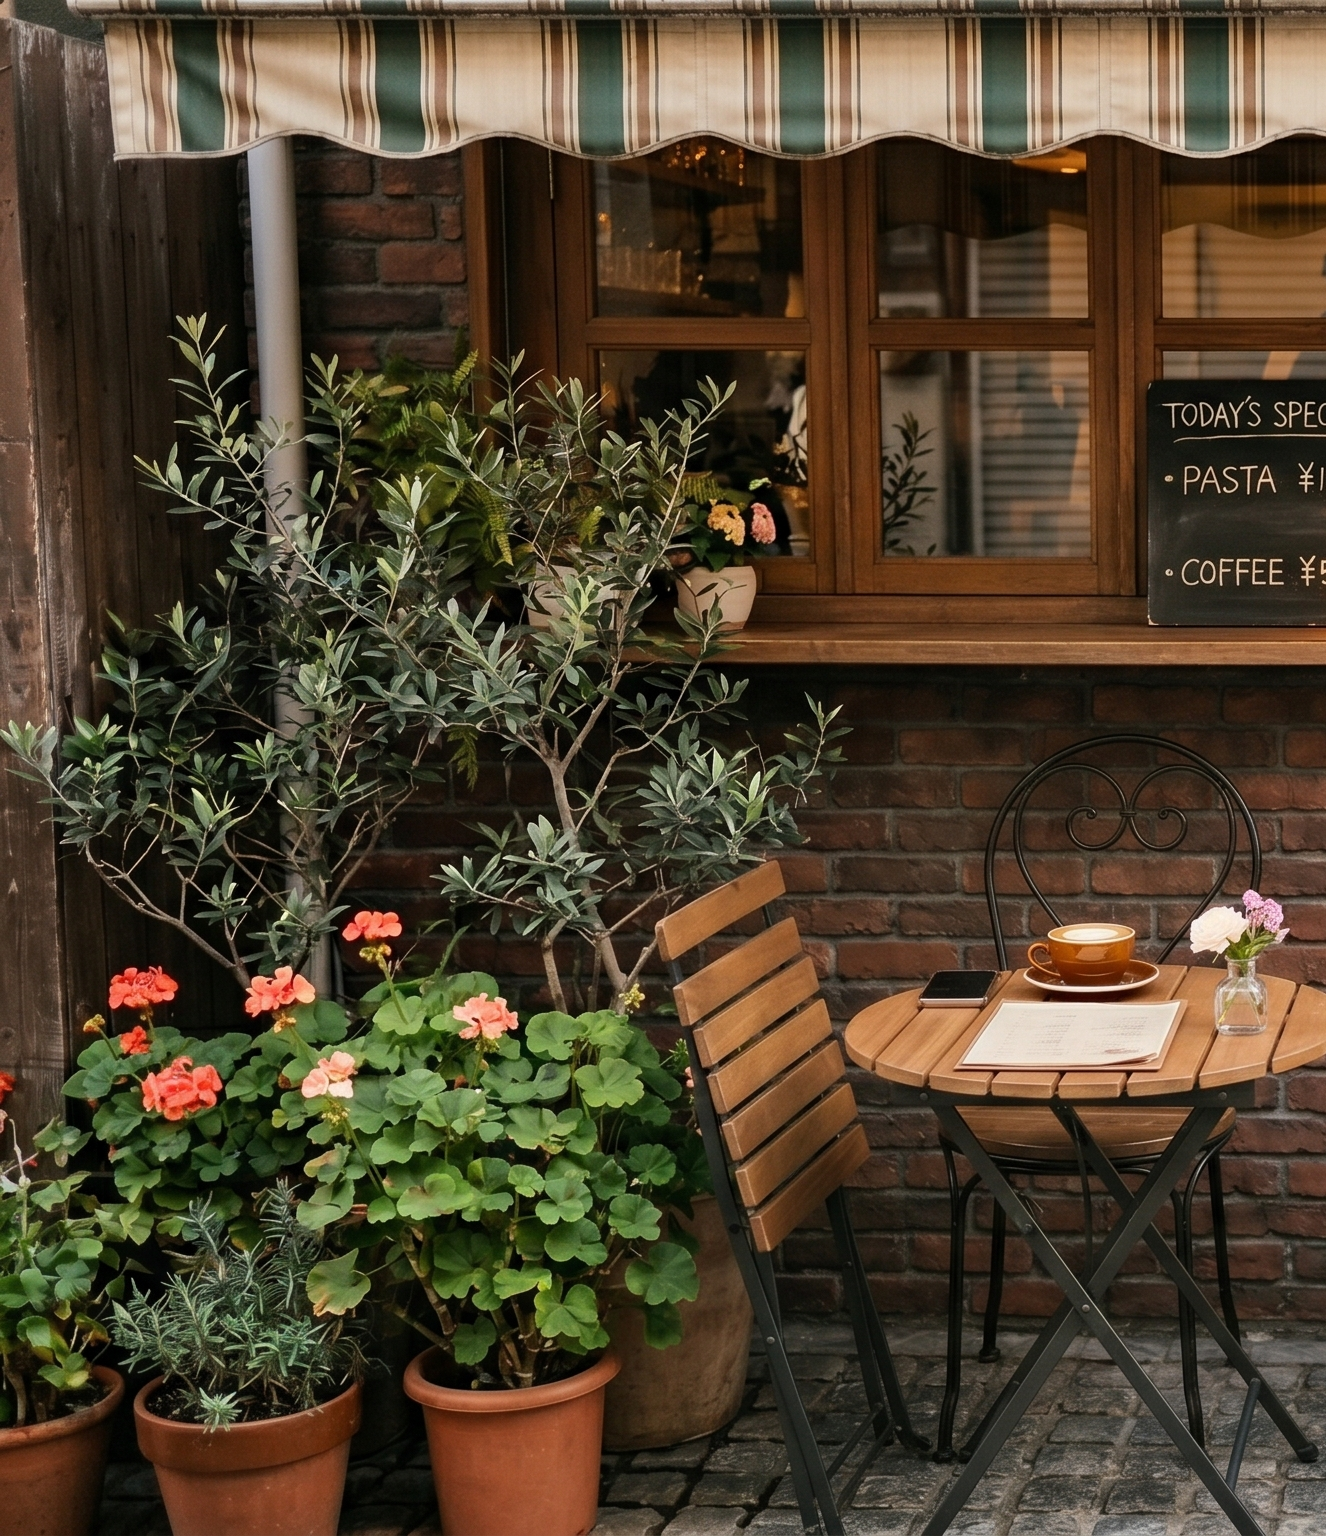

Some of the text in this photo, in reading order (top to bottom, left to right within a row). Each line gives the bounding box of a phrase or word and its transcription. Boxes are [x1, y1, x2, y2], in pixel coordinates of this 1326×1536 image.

[1160, 395, 1262, 429] TODAY'S
[1183, 464, 1277, 496] PASTA
[1181, 557, 1285, 587] COFFEE
